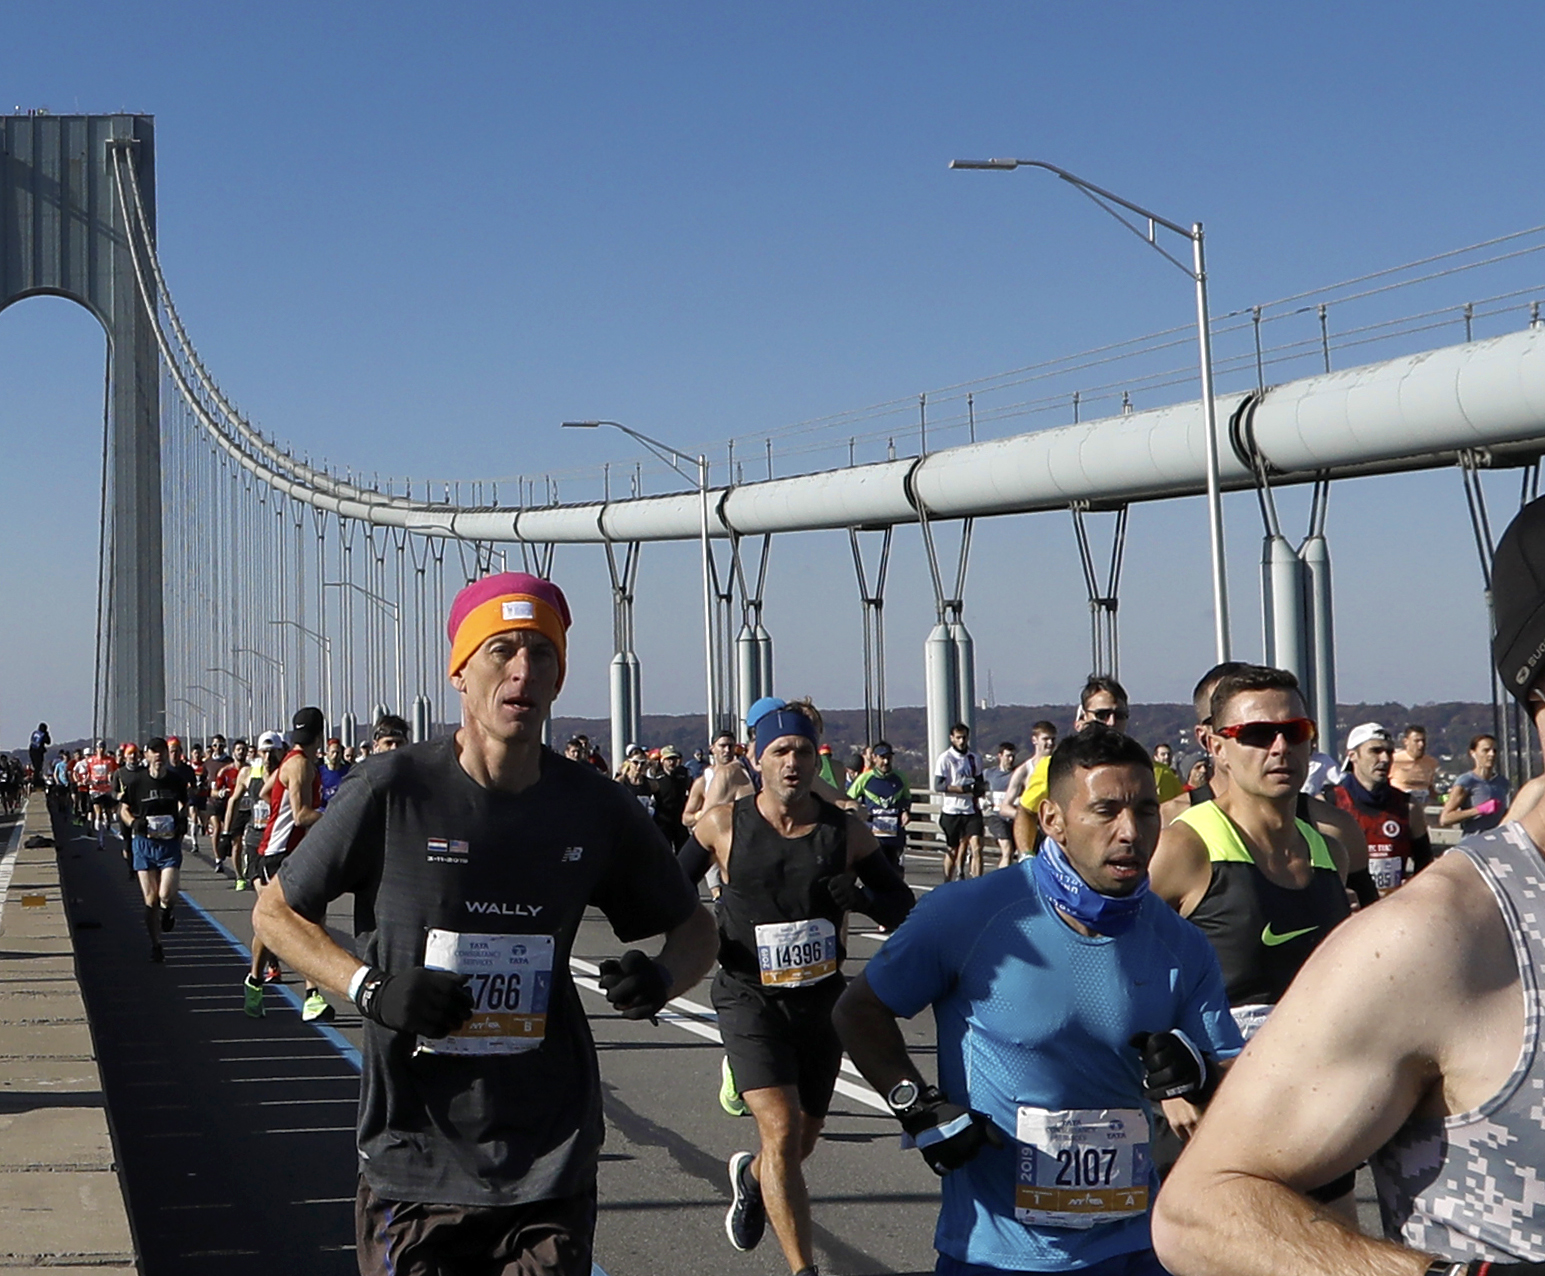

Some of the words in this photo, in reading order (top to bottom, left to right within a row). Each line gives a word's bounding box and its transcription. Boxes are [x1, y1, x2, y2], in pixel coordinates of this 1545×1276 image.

[465, 901, 543, 917] WALLY
[469, 942, 489, 950] TATA
[776, 941, 822, 968] 14396
[509, 957, 529, 965] TATA
[1107, 1132, 1126, 1140] TATA
[1020, 1147, 1034, 1182] 2019
[1055, 1148, 1118, 1186] 2107
[1034, 1195, 1039, 1205] 1
[1125, 1196, 1135, 1206] A
